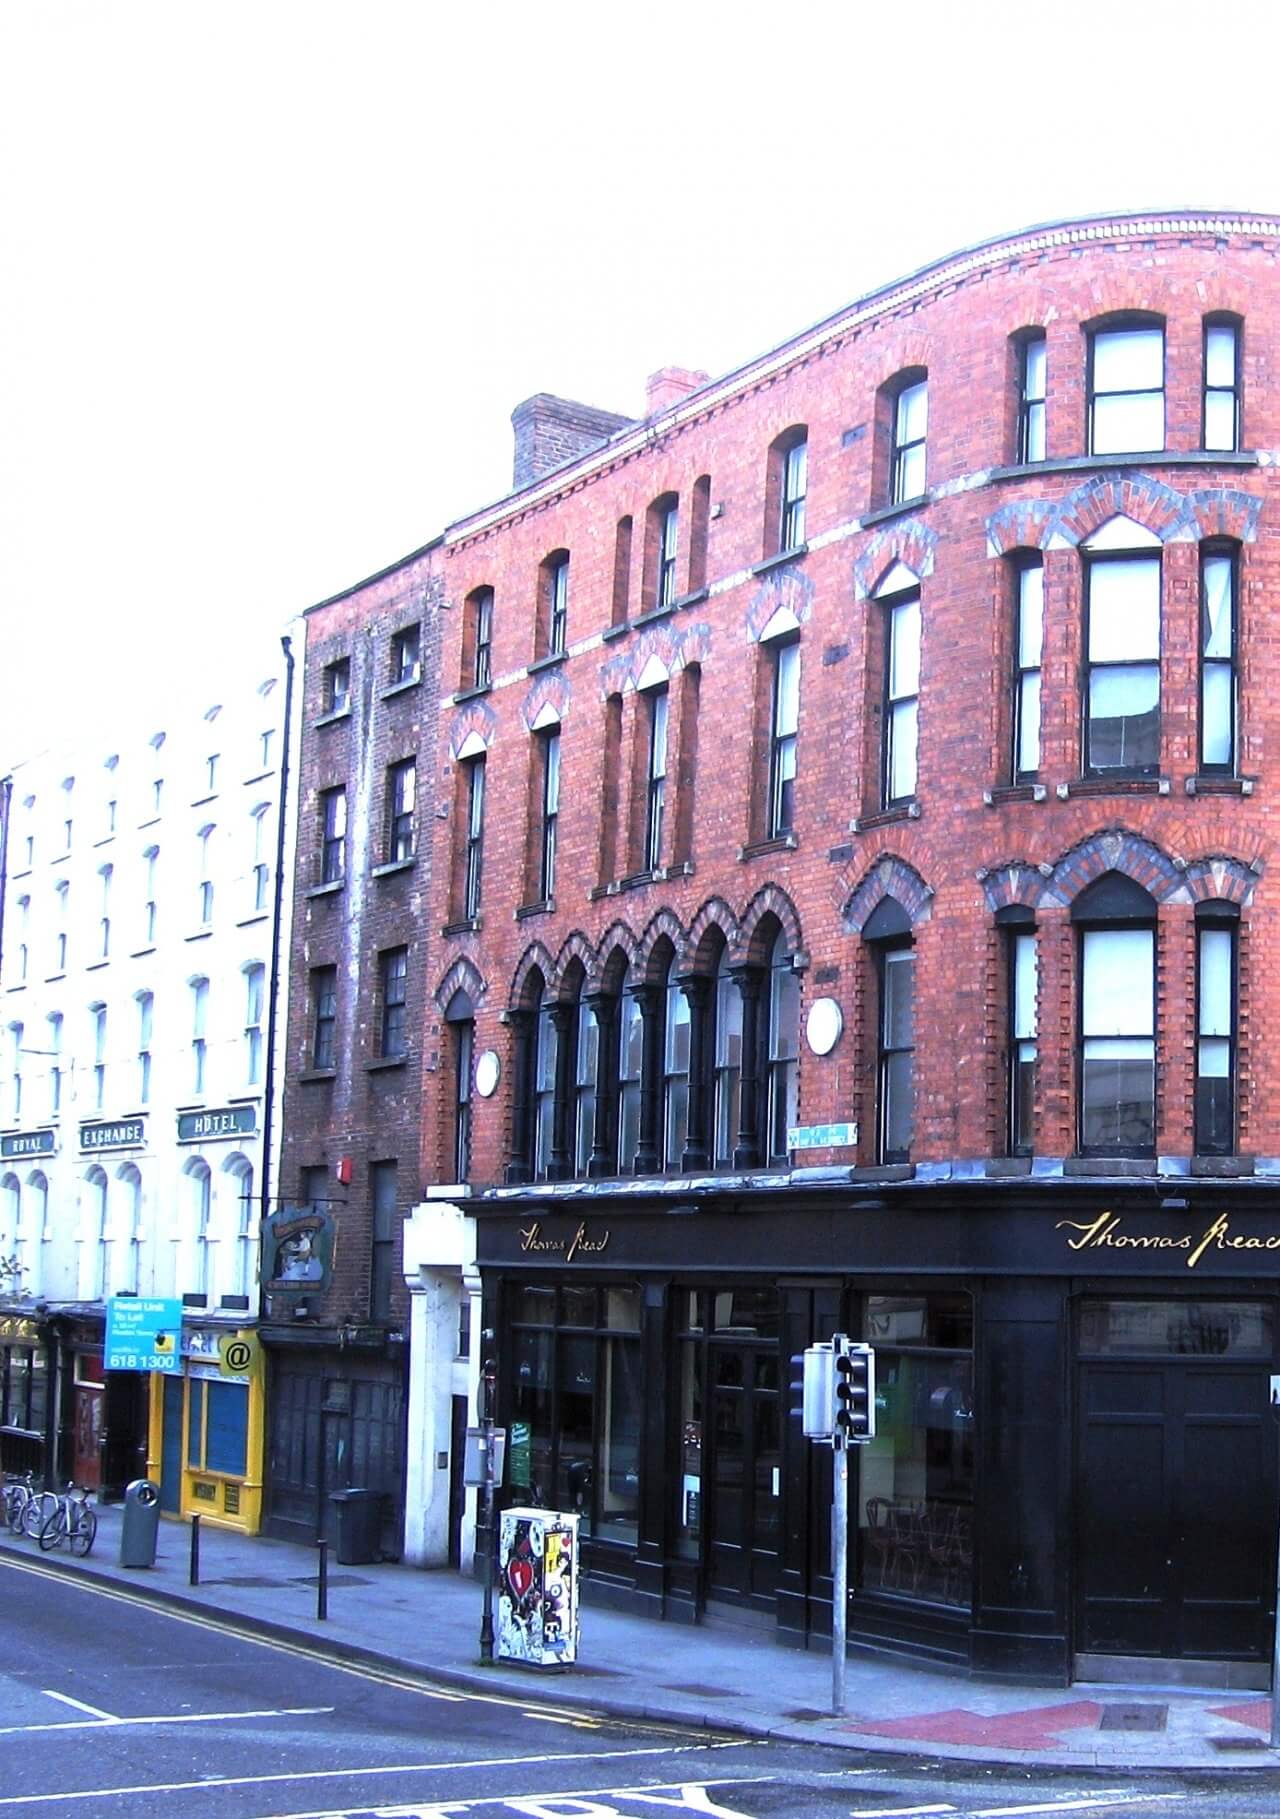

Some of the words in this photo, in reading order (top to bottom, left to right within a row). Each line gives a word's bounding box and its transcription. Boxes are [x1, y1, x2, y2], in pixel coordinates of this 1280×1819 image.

[12, 1137, 41, 1153] ROYAL
[84, 1126, 140, 1145] EXCHANGE
[194, 1114, 237, 1133] HOTEL
[520, 1223, 565, 1251] Thomas
[1055, 1211, 1192, 1250] Thomas
[110, 1355, 137, 1368] 618
[140, 1355, 175, 1369] 1300
